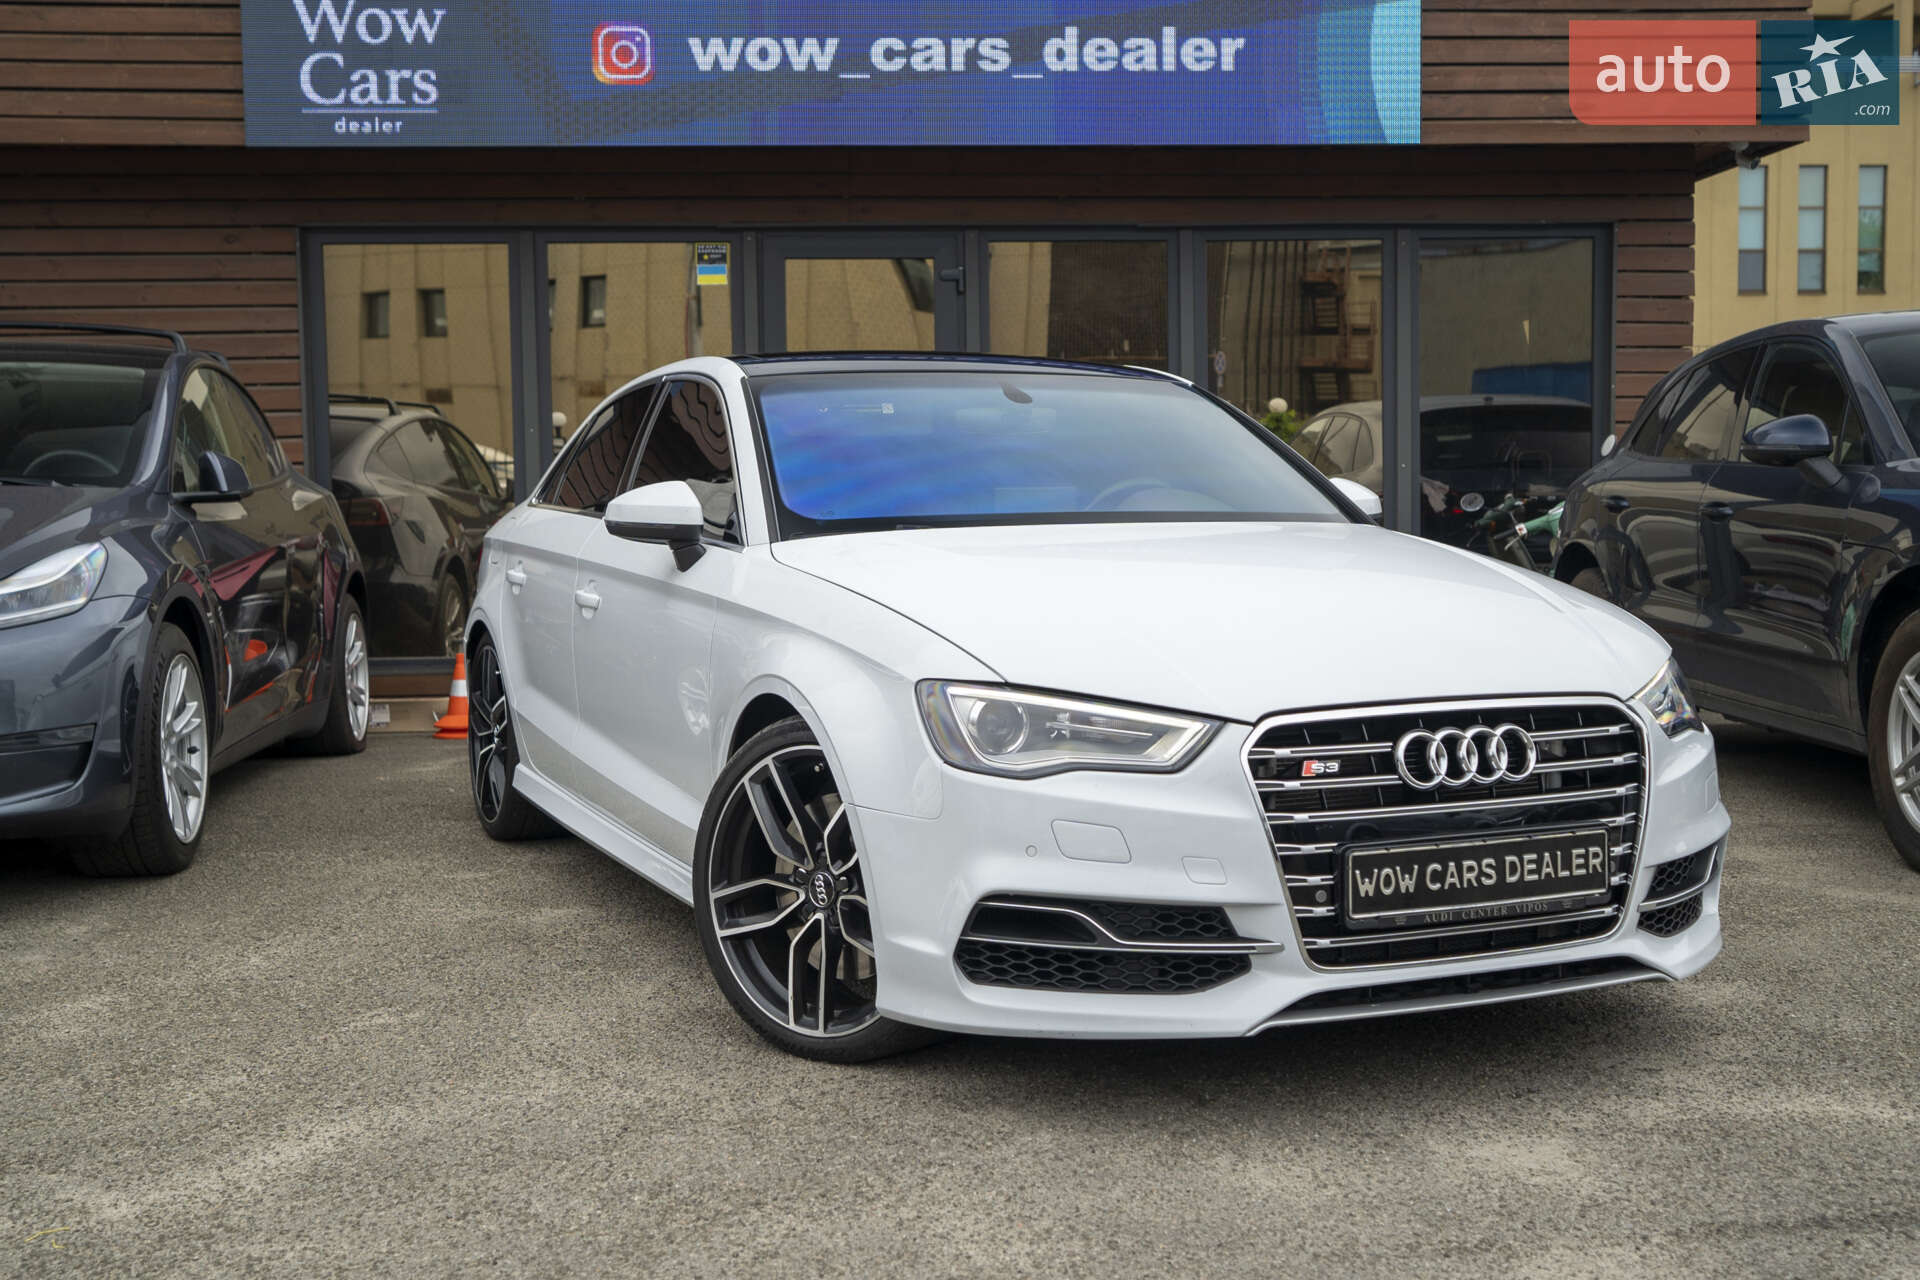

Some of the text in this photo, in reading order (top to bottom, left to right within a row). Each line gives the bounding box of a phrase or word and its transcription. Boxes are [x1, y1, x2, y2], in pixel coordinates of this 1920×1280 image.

[293, 0, 447, 44] Wow
[688, 27, 1246, 78] wow_cars_dealer
[300, 52, 438, 105] Cars
[334, 116, 402, 134] dealer
[1311, 762, 1339, 774] S3
[1355, 847, 1604, 897] WOW CARS DEALER
[1423, 911, 1453, 924] AUDI
[1461, 906, 1508, 920] CENTER
